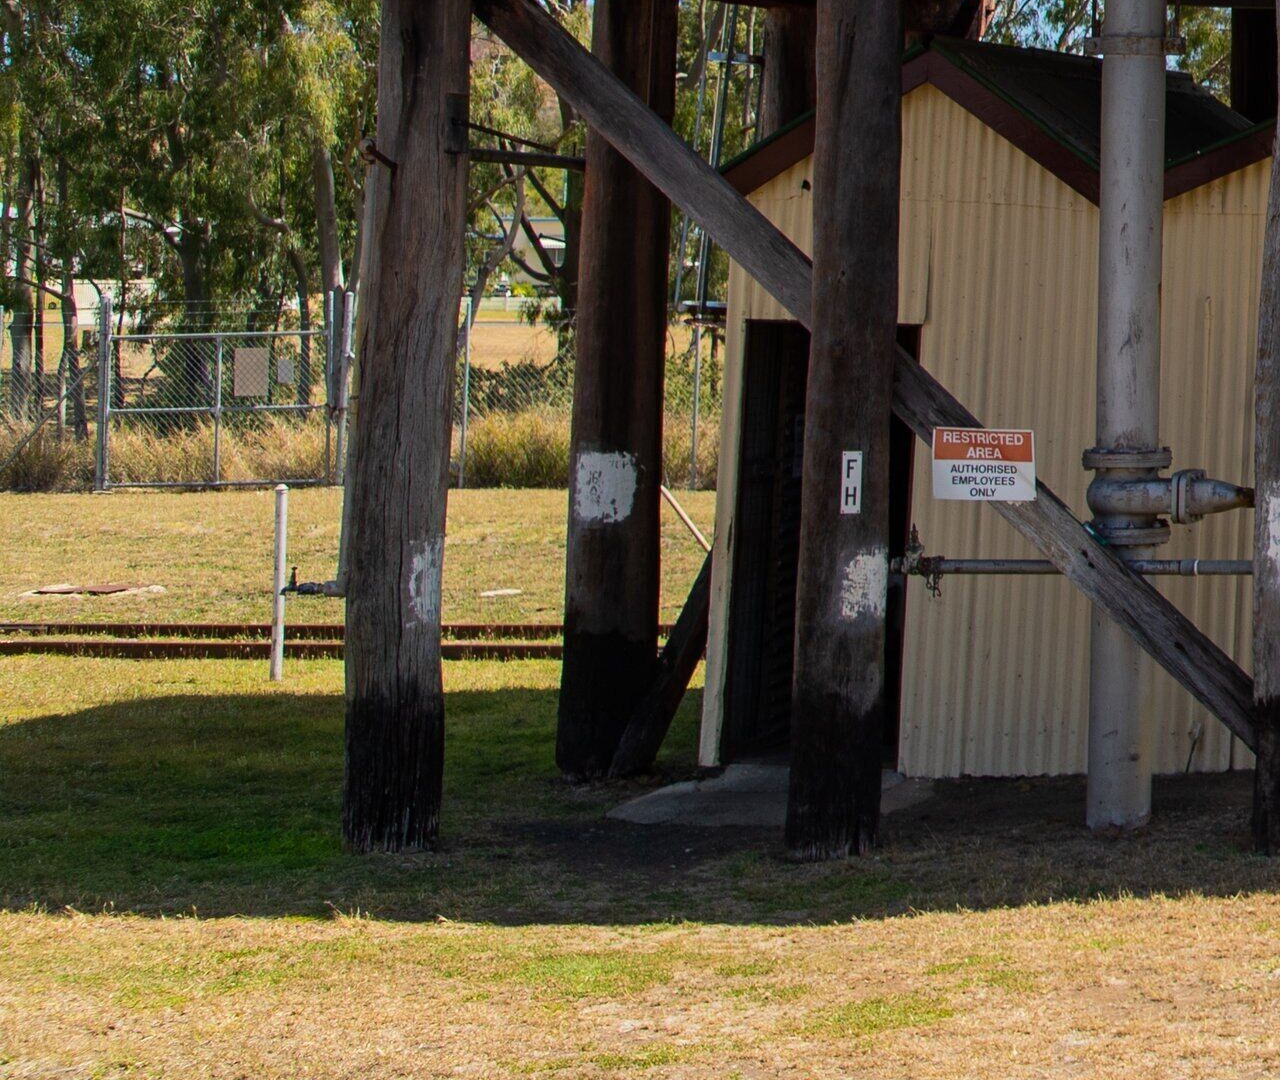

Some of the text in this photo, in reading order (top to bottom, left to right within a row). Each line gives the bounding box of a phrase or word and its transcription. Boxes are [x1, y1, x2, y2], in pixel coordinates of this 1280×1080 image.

[943, 431, 1024, 446] RESTRICTED
[966, 447, 1003, 459] AREA
[950, 464, 1018, 474] AUTHORISED
[952, 476, 1015, 486] EMPLOYEES
[969, 487, 997, 497] ONLY
